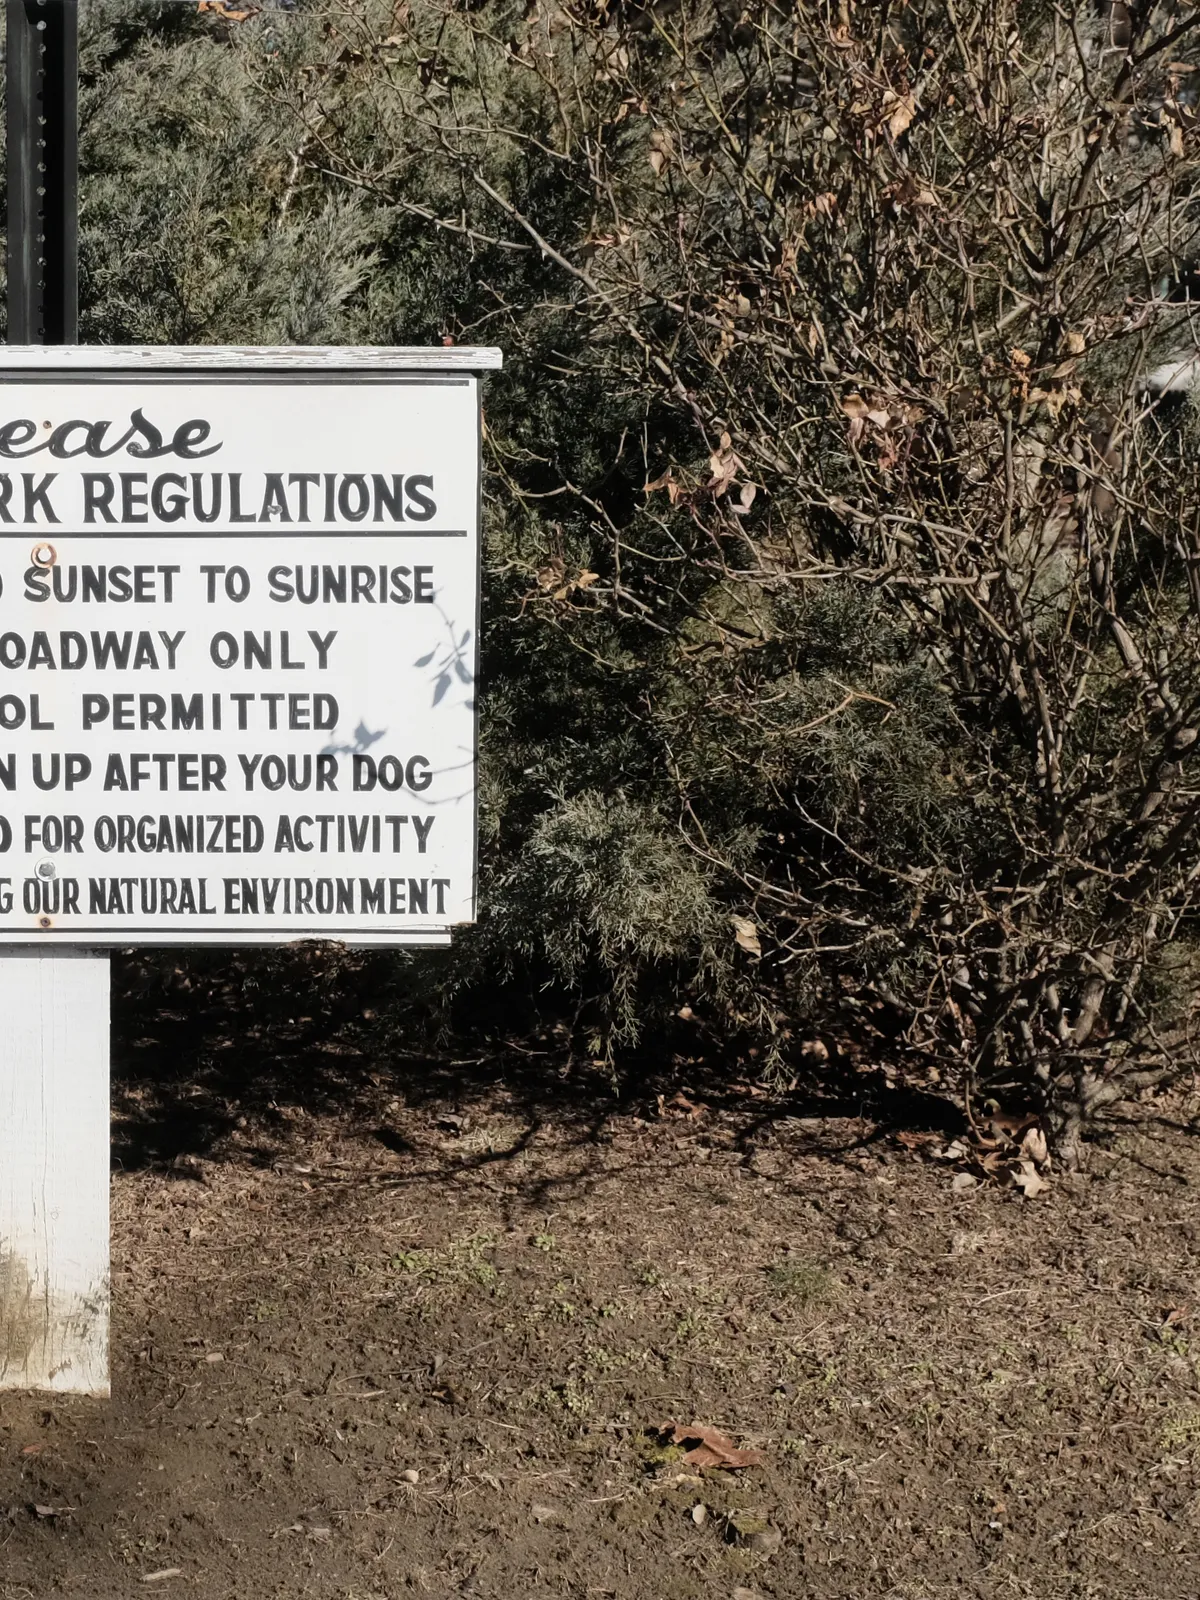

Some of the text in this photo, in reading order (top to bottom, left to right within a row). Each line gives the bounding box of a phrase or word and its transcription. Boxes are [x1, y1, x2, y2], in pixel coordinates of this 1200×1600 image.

[82, 472, 437, 523] REGULATIONS
[23, 564, 180, 603] SUNSET
[200, 565, 250, 603] TO
[268, 565, 434, 604] SUNRISE
[210, 630, 338, 670] ONLY
[82, 693, 339, 731] PERMITTED
[32, 753, 92, 791] UP
[103, 753, 227, 791] AFTER
[238, 753, 339, 792] YOUR
[352, 754, 433, 792] DOG
[24, 815, 84, 853] FOR
[94, 815, 264, 853] ORGANIZED
[274, 815, 436, 853] ACTIVITY
[23, 877, 82, 915] OUR
[88, 877, 217, 914] NATURAL
[222, 878, 451, 914] ENVIRONMENT
